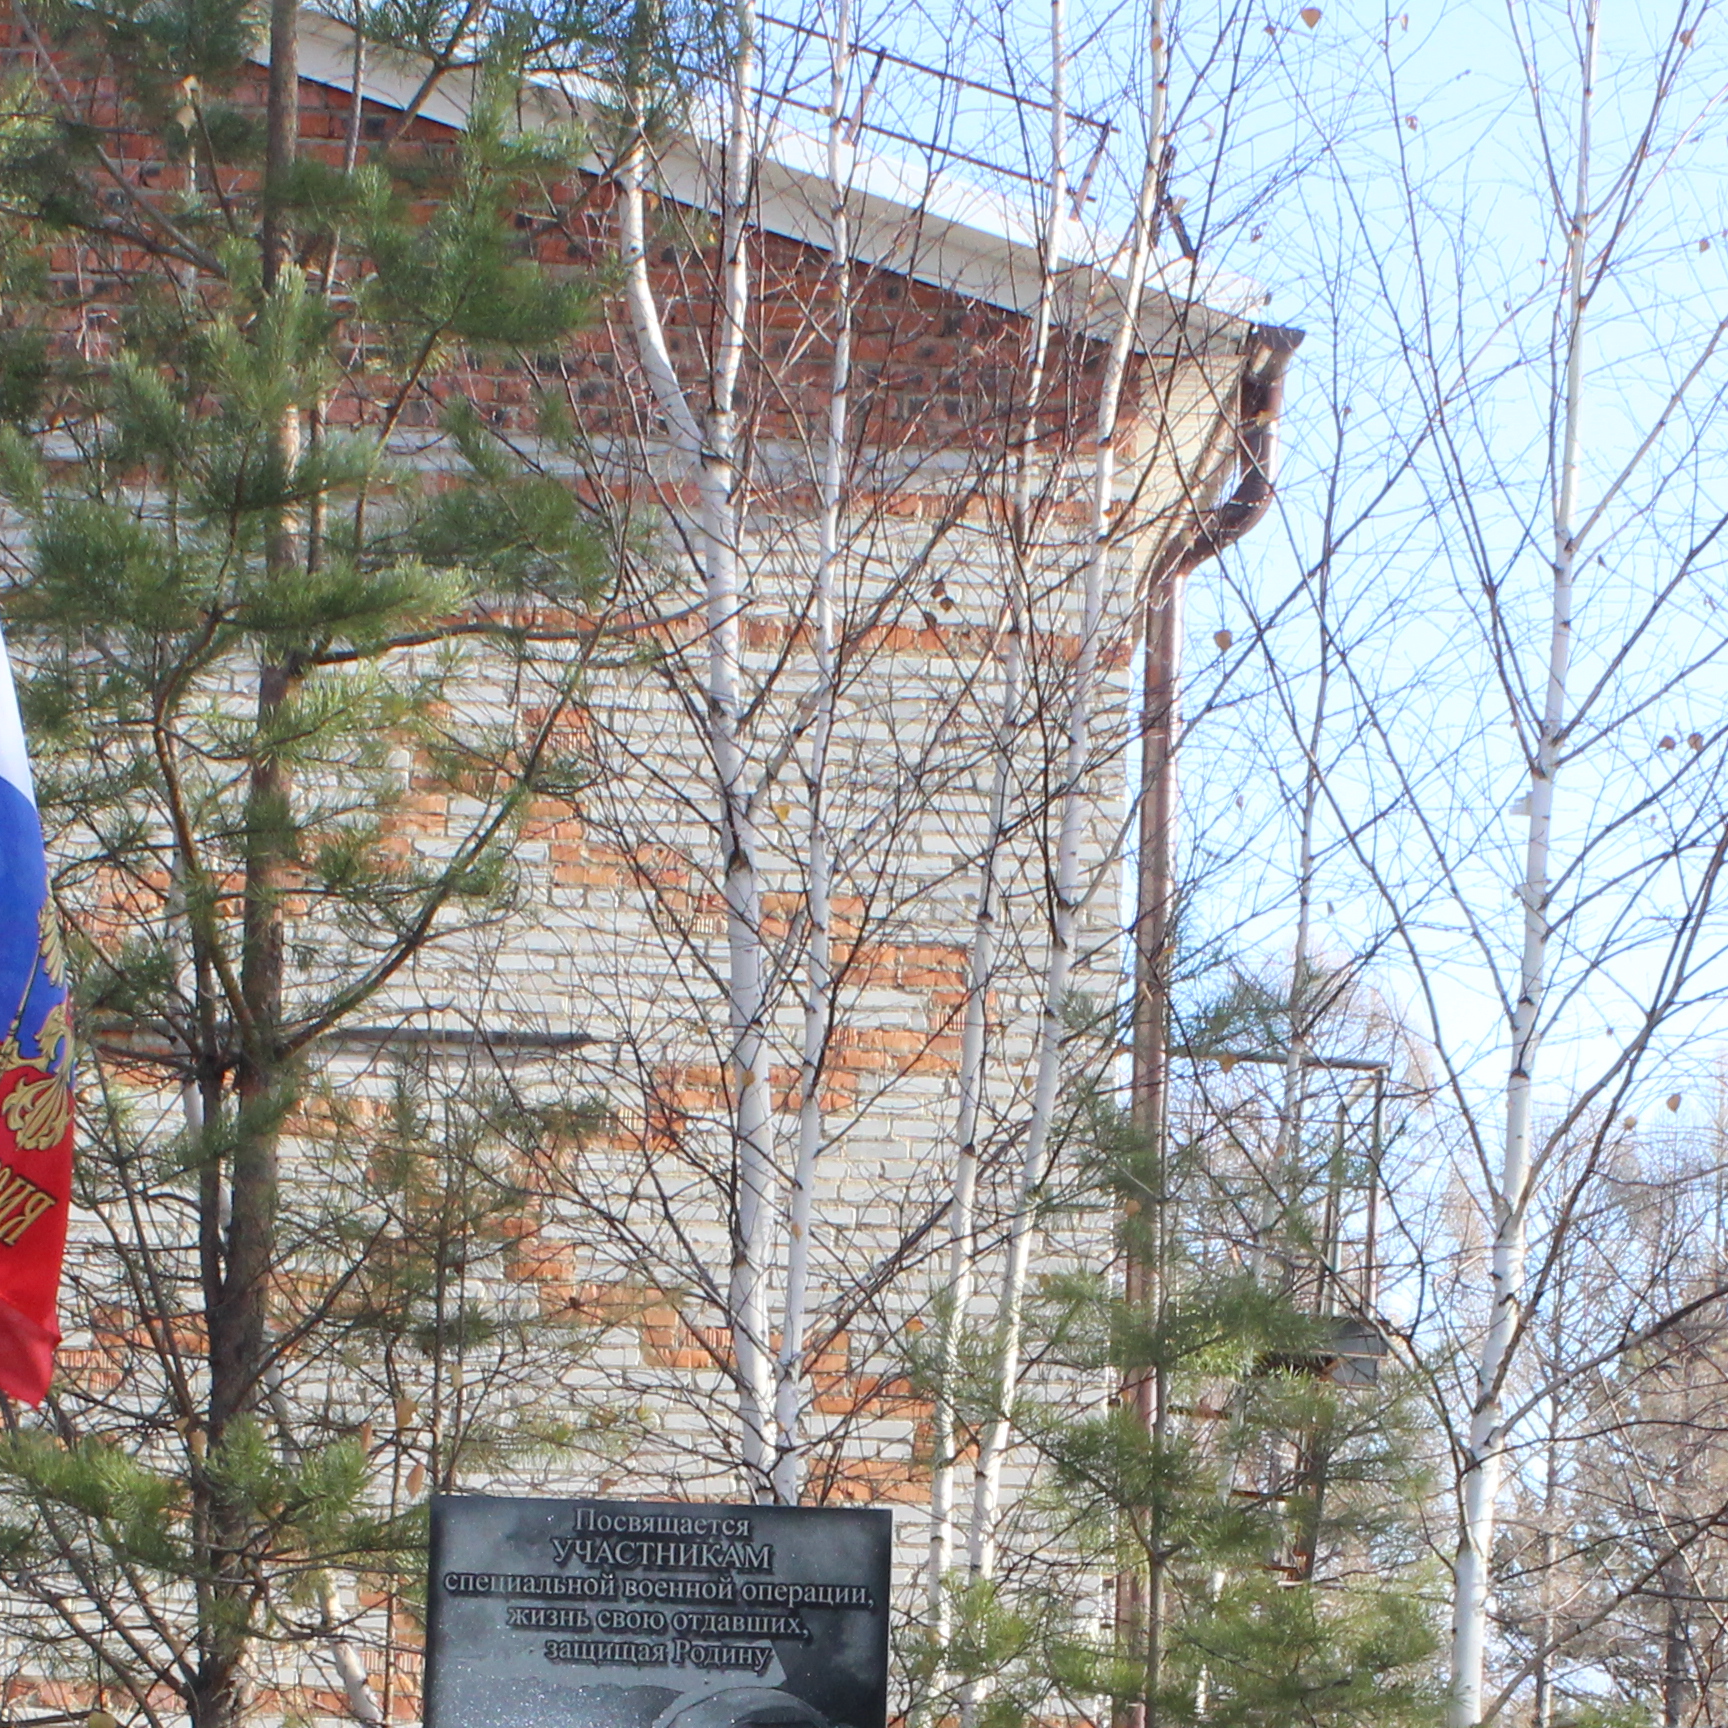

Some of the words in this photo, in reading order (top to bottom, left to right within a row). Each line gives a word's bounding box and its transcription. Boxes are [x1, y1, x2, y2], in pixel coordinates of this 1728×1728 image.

[574, 1508, 750, 1537] Посвящается
[552, 1538, 771, 1569] УЧАСТНИКАМ
[444, 1571, 615, 1598] специальной
[623, 1575, 733, 1601] военной
[741, 1582, 875, 1609] операции,
[507, 1608, 590, 1629] жизнь
[596, 1611, 665, 1631] свою
[672, 1612, 810, 1637] отдавших,
[545, 1640, 669, 1665] защищая
[672, 1641, 771, 1671] Родину
